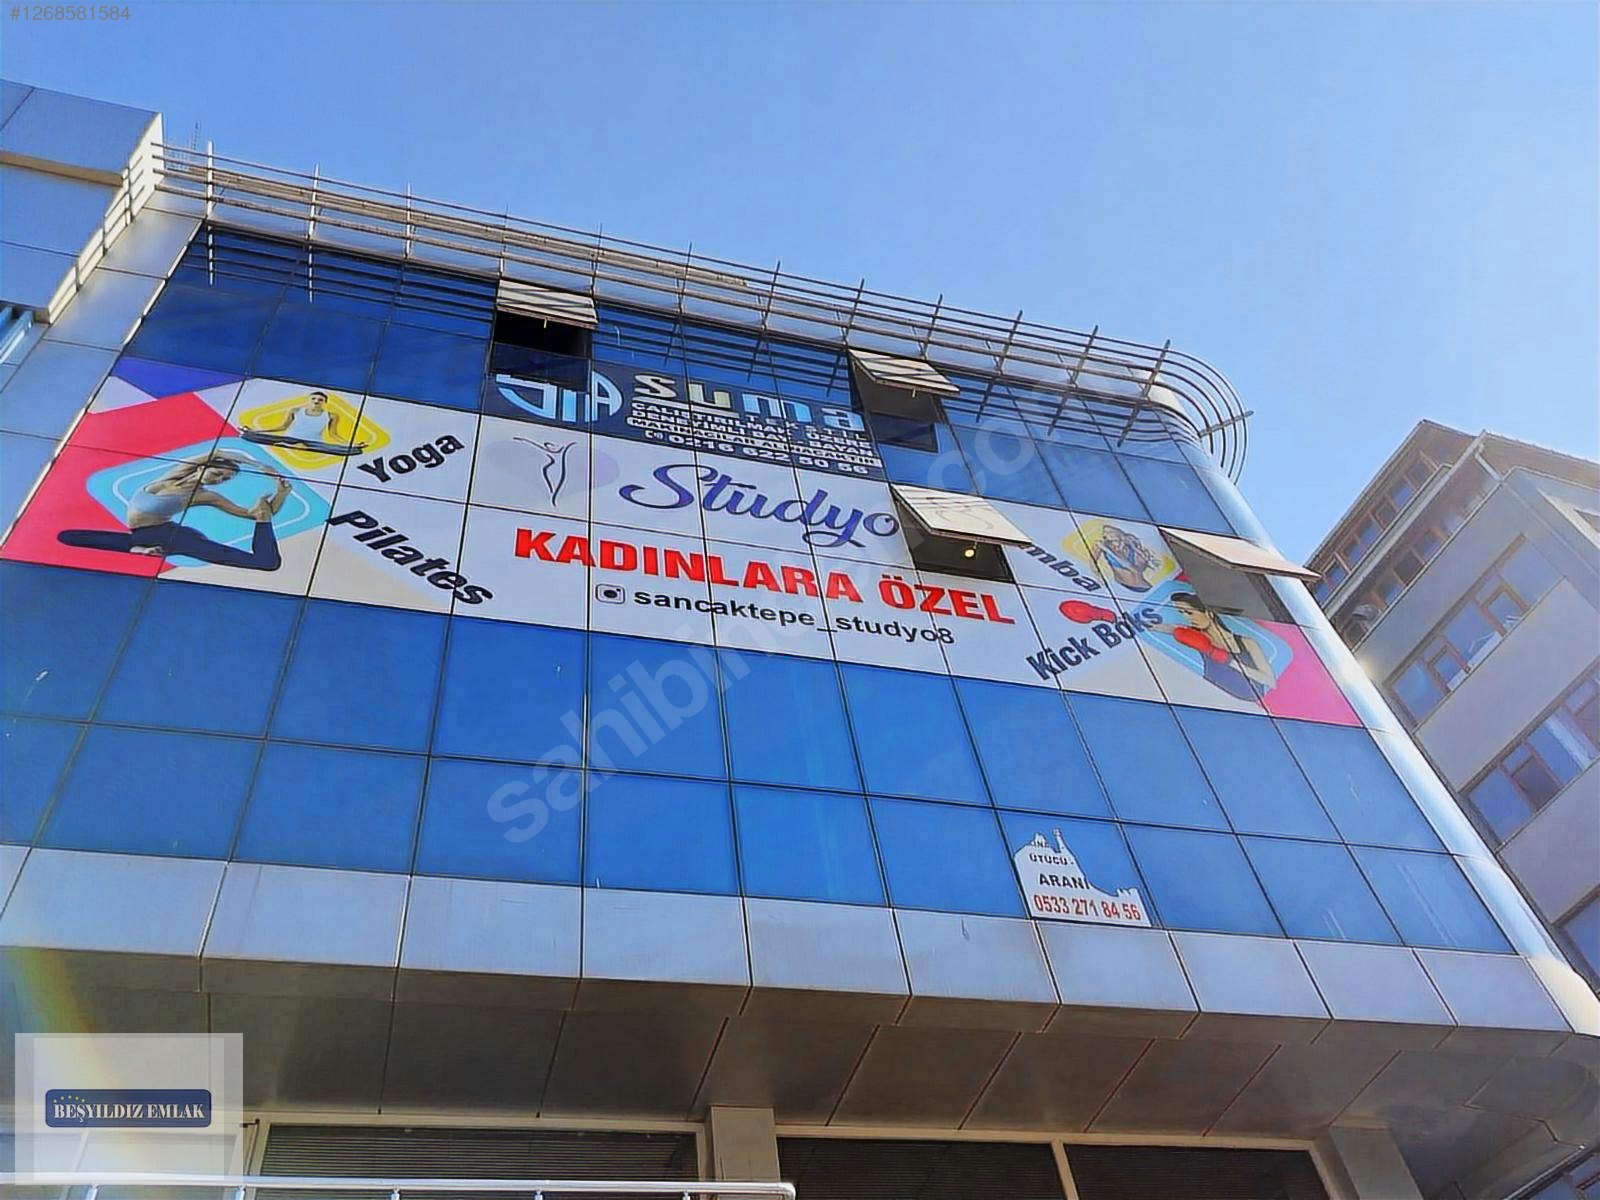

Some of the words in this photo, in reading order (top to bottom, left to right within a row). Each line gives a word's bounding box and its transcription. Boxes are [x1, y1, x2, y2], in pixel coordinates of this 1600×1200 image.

[633, 374, 866, 433] suma
[357, 432, 465, 484] Yoga
[668, 434, 735, 453] 0216
[742, 447, 792, 462] 622
[799, 457, 829, 468] 50
[838, 463, 869, 475] 56
[809, 440, 873, 457] BAYAN
[328, 509, 494, 606] Pilates
[514, 527, 864, 608] KADINLARA
[881, 567, 1017, 624] ÖZEL
[1018, 543, 1104, 594] mba
[633, 587, 957, 646] sancaktepe_studyo8
[1026, 636, 1101, 681] Kick
[1033, 894, 1070, 914] 0533
[1071, 899, 1099, 917] 271
[1101, 902, 1120, 919] 84
[1121, 905, 1141, 921] 56
